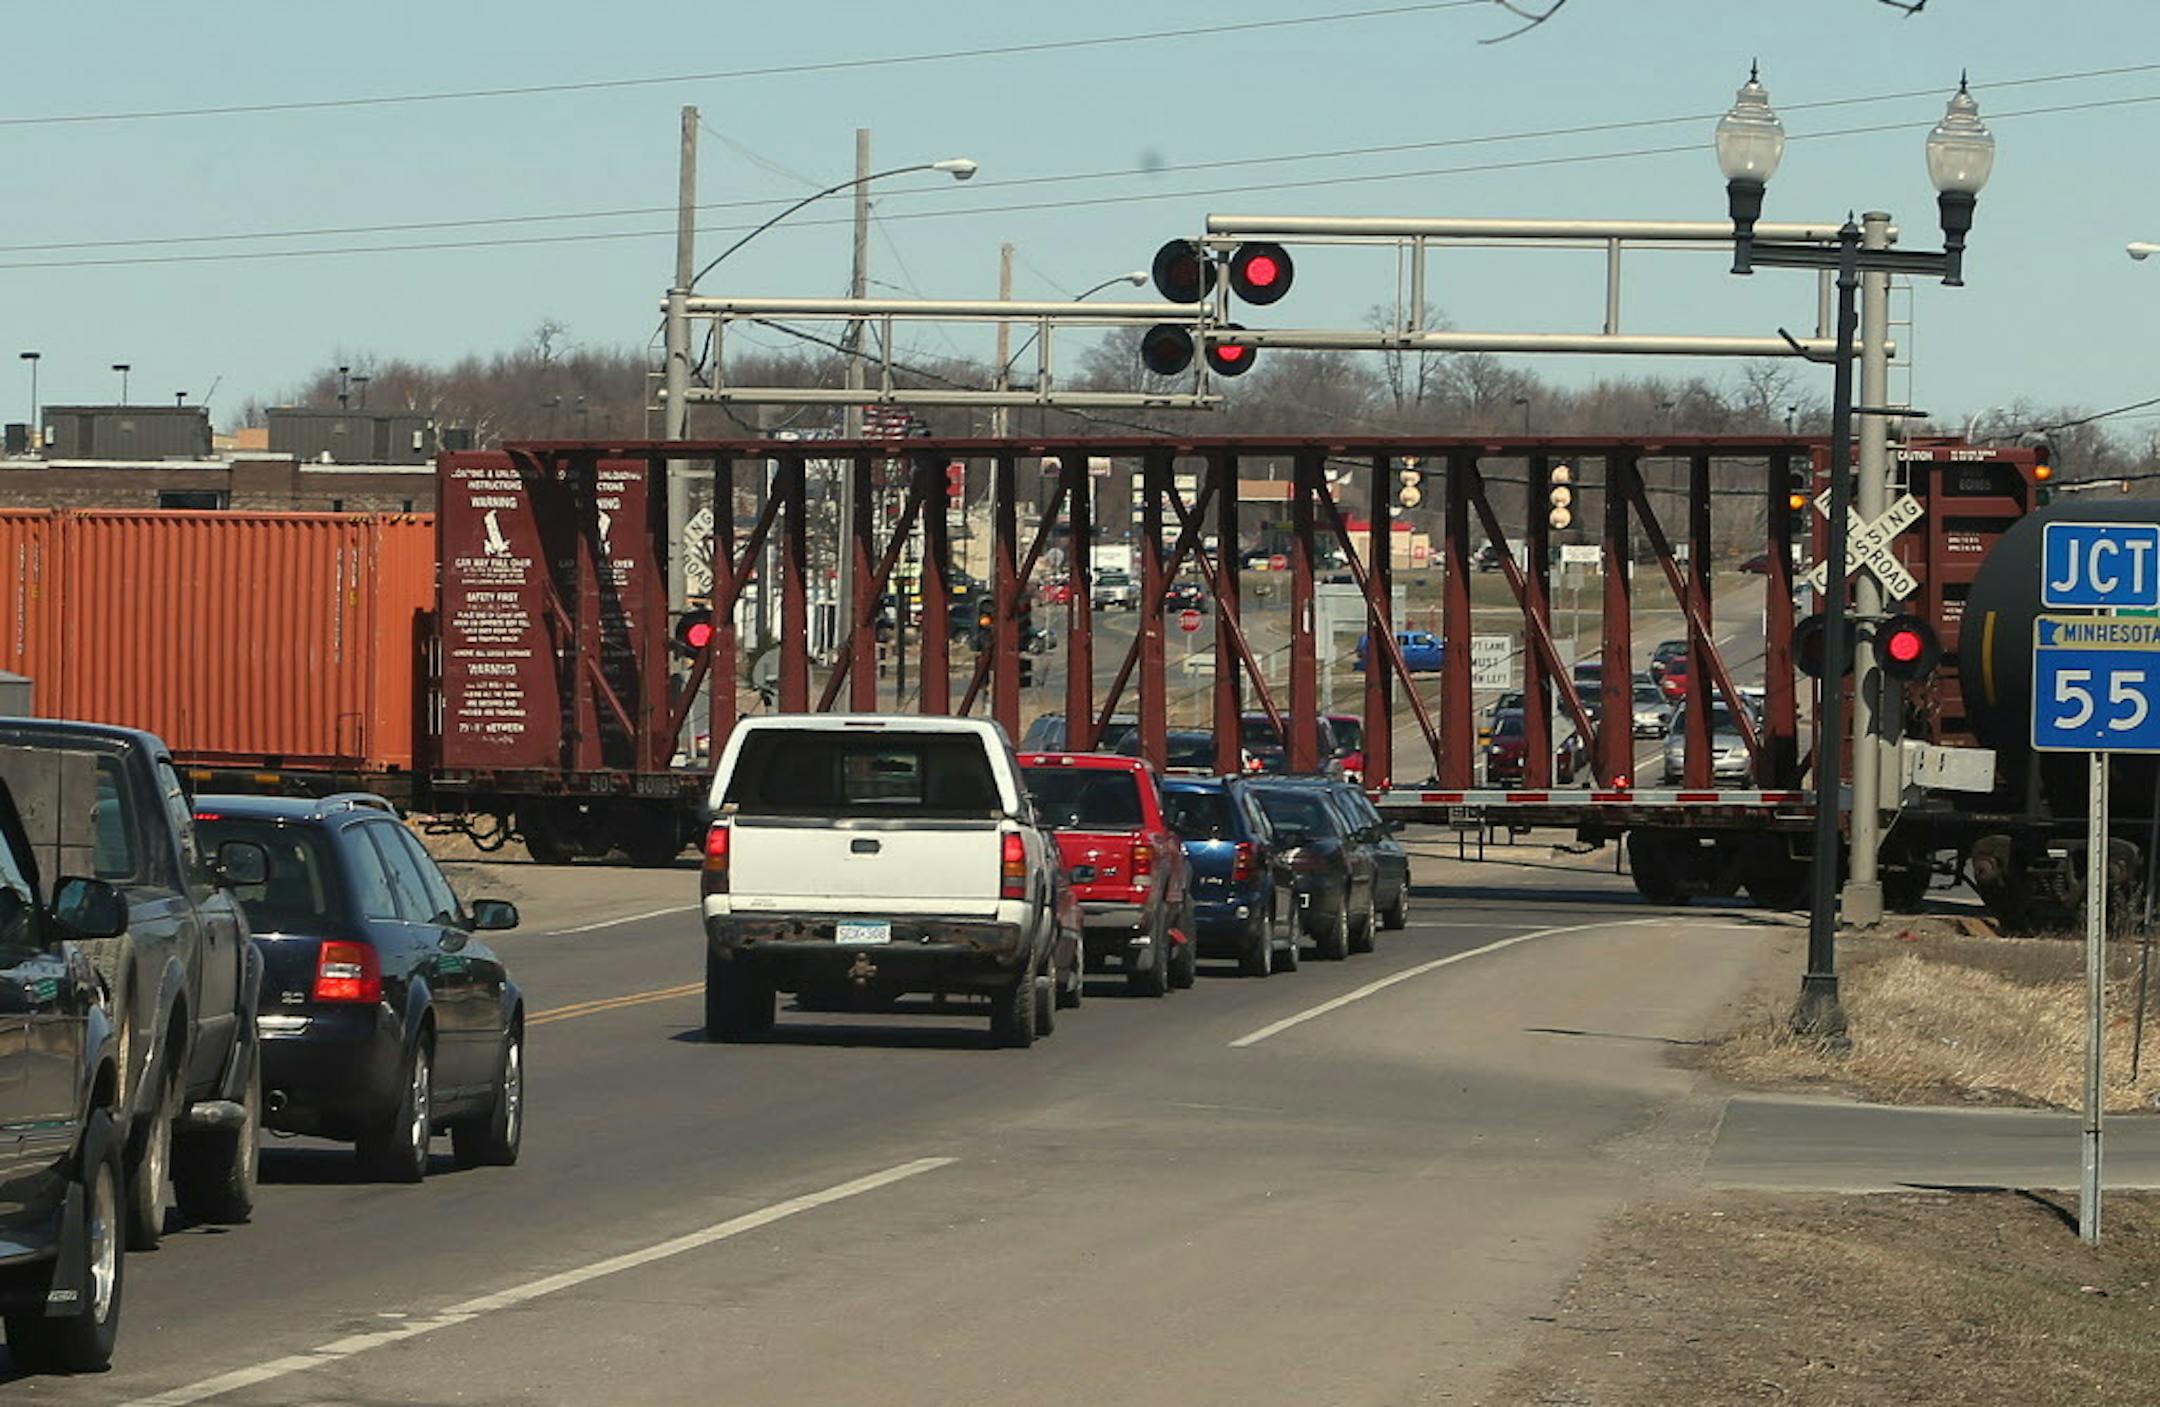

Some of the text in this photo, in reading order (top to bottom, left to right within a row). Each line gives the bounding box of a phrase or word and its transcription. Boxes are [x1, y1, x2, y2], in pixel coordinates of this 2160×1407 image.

[1897, 450, 1934, 461] CAUTION
[470, 496, 518, 508] WARNING
[1815, 499, 1918, 588] COSSING
[2050, 538, 2153, 594] JCT
[1868, 547, 1910, 594] ROAD
[2062, 624, 2160, 643] MINNESOTA
[2053, 669, 2149, 731] 55
